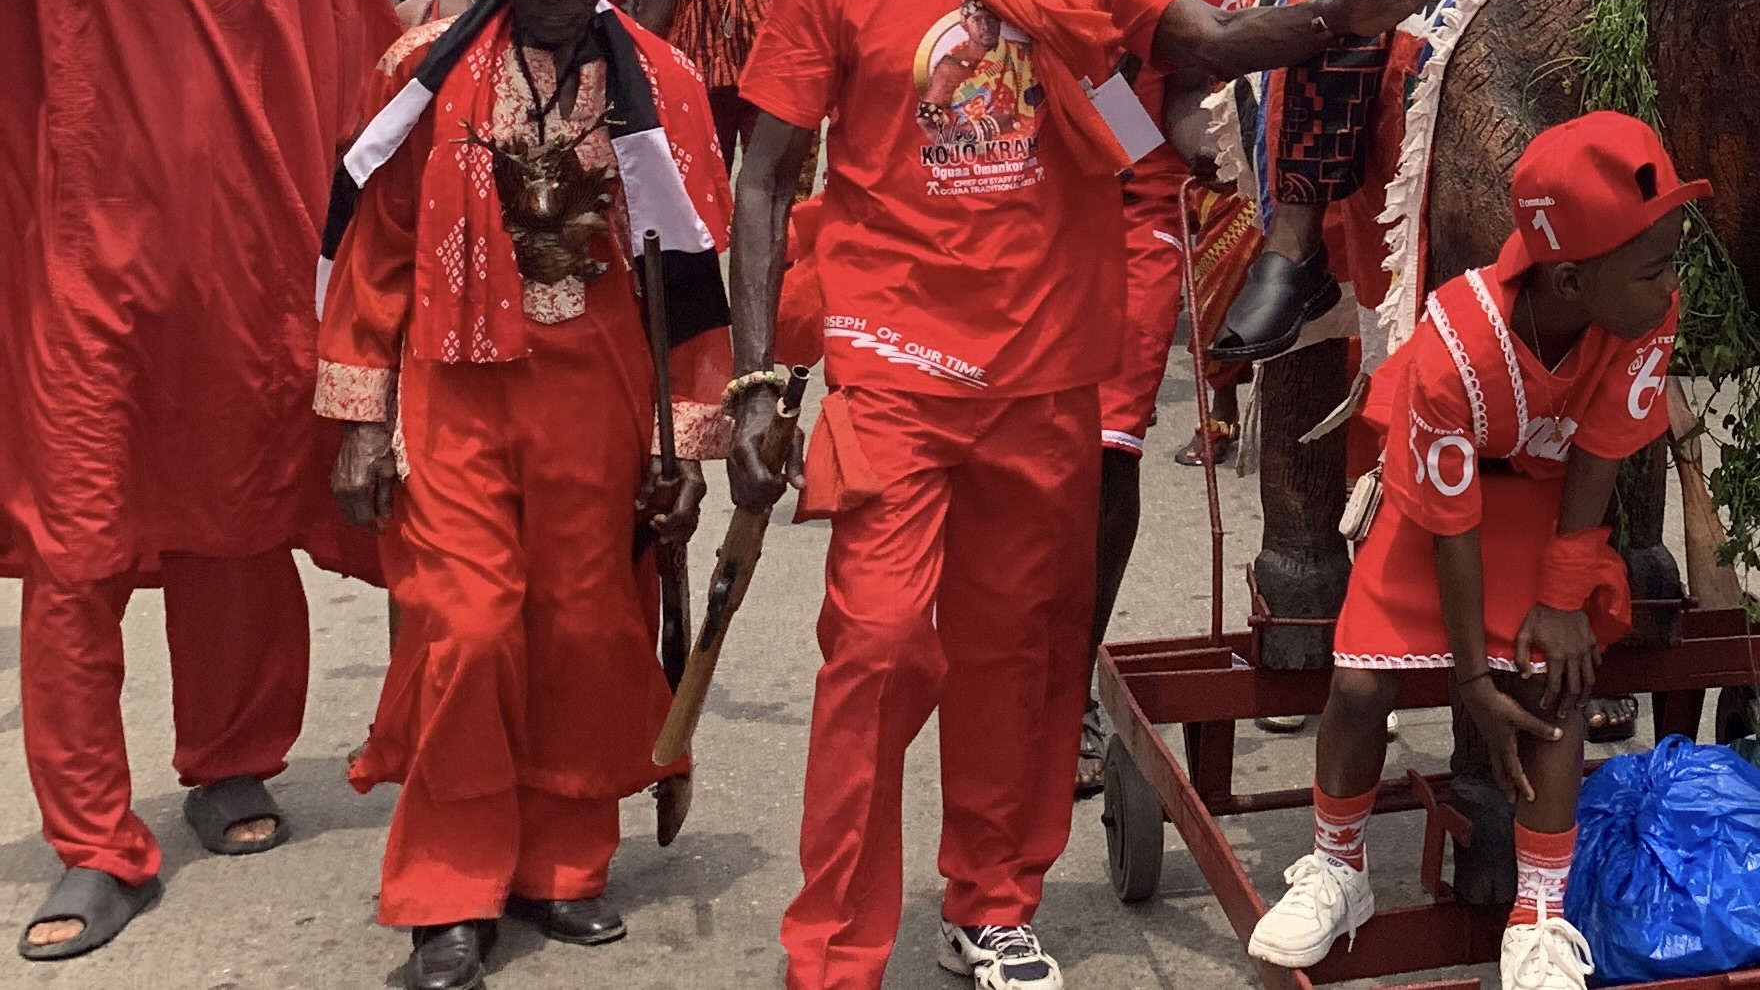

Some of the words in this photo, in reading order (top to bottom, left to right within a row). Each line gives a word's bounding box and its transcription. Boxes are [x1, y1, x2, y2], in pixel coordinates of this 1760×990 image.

[920, 143, 977, 166] KOJO
[977, 178, 989, 186] OF
[989, 175, 1013, 185] STAFF
[876, 327, 903, 344] OF
[904, 342, 943, 364] OUR
[945, 355, 986, 380] TIME
